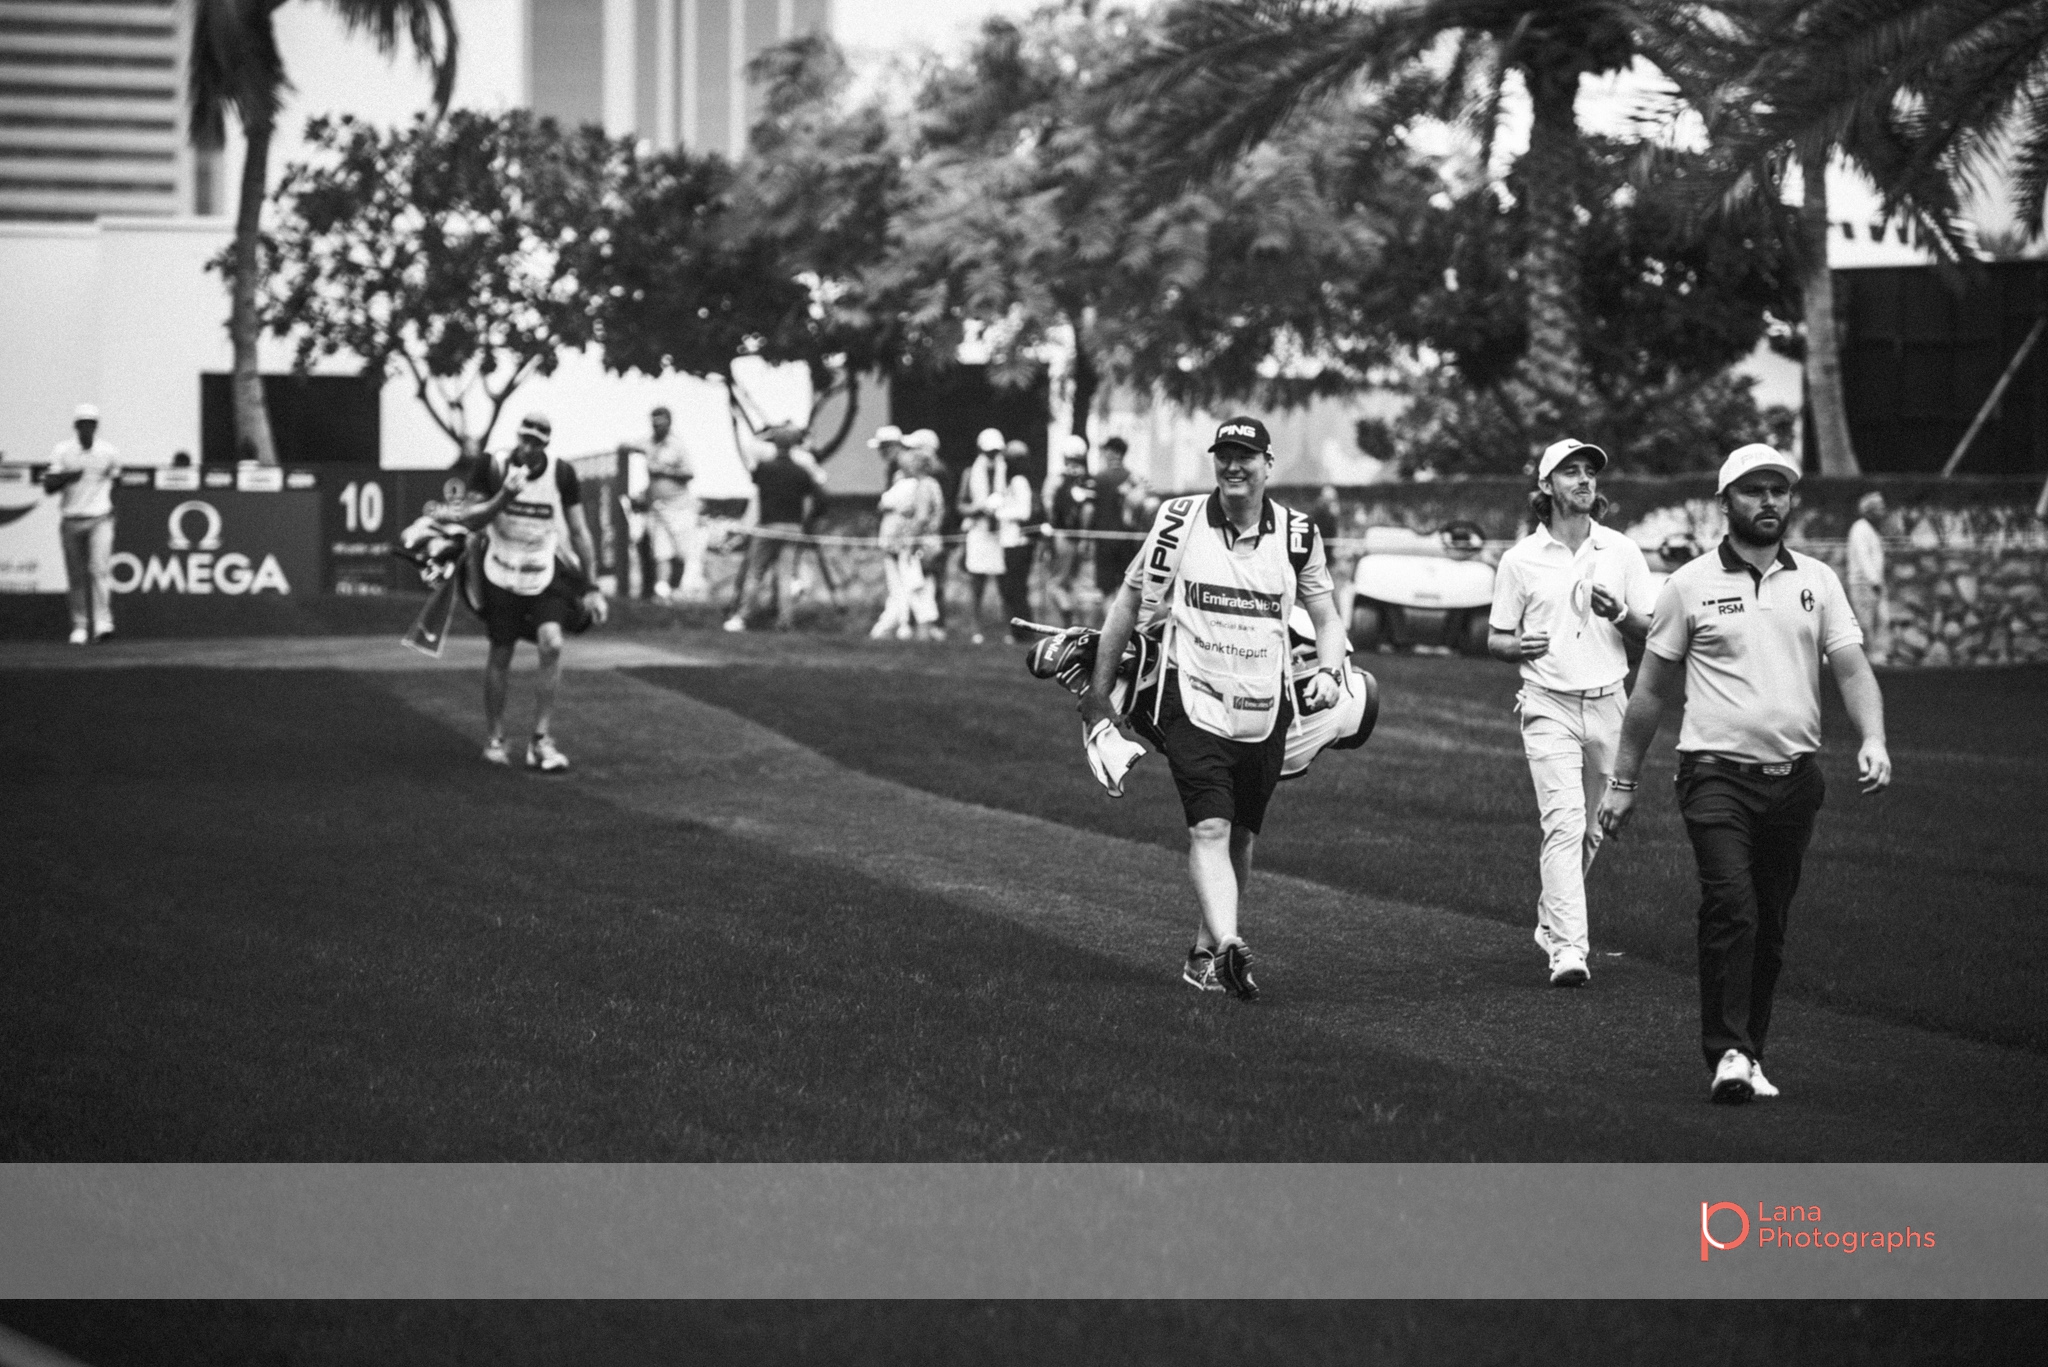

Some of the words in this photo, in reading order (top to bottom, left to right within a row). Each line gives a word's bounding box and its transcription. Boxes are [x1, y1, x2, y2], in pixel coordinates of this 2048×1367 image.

[1218, 424, 1257, 439] PING
[339, 481, 384, 532] 10
[1150, 499, 1195, 573] PING
[1290, 507, 1309, 554] PIN
[105, 551, 292, 595] OMEGA
[1202, 590, 1255, 610] Emirates
[1718, 603, 1745, 615] RSM
